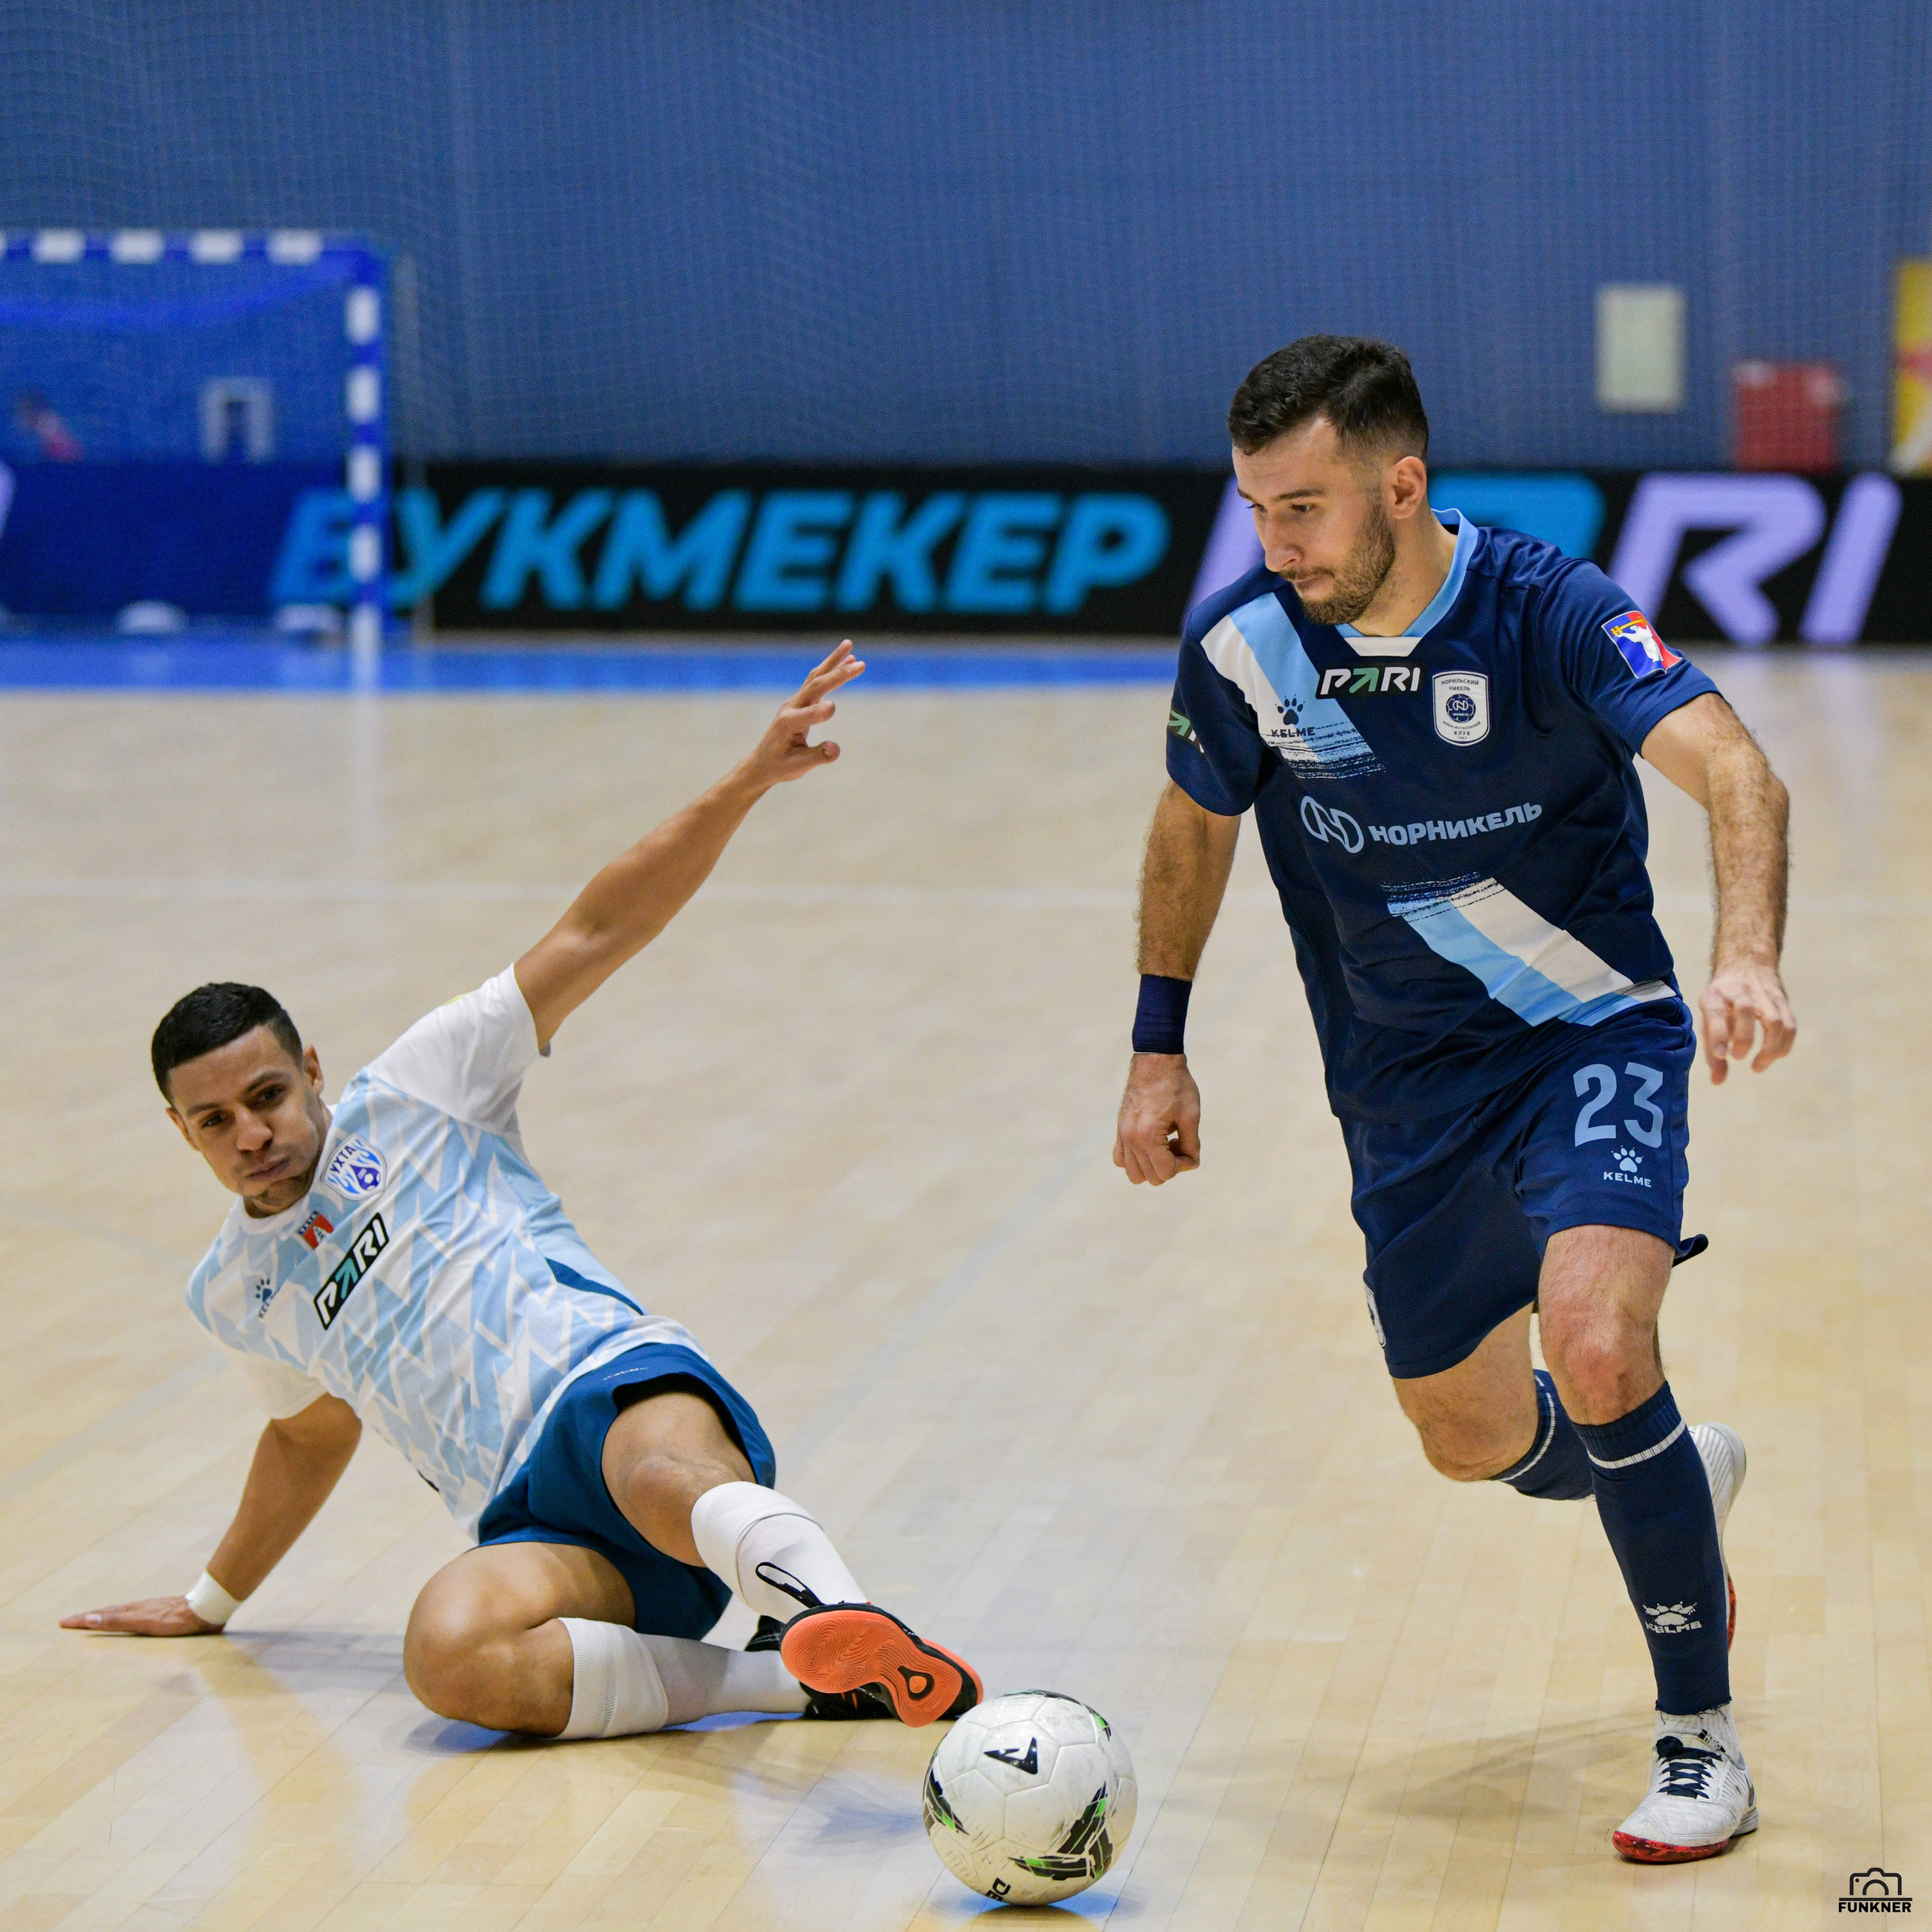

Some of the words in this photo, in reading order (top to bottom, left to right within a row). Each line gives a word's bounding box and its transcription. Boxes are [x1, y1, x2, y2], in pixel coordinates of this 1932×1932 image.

[270, 488, 1171, 613] БУКМЕКЕР
[1320, 666, 1420, 694] PARI
[1271, 727, 1316, 738] KELME
[1367, 802, 1543, 846] НОРНИКЕЛЬ
[1573, 1061, 1664, 1149] 23
[330, 1146, 357, 1174] УХТА
[1603, 1171, 1652, 1188] KELME
[316, 1218, 386, 1325] PARI
[1645, 1620, 1703, 1634] KELME
